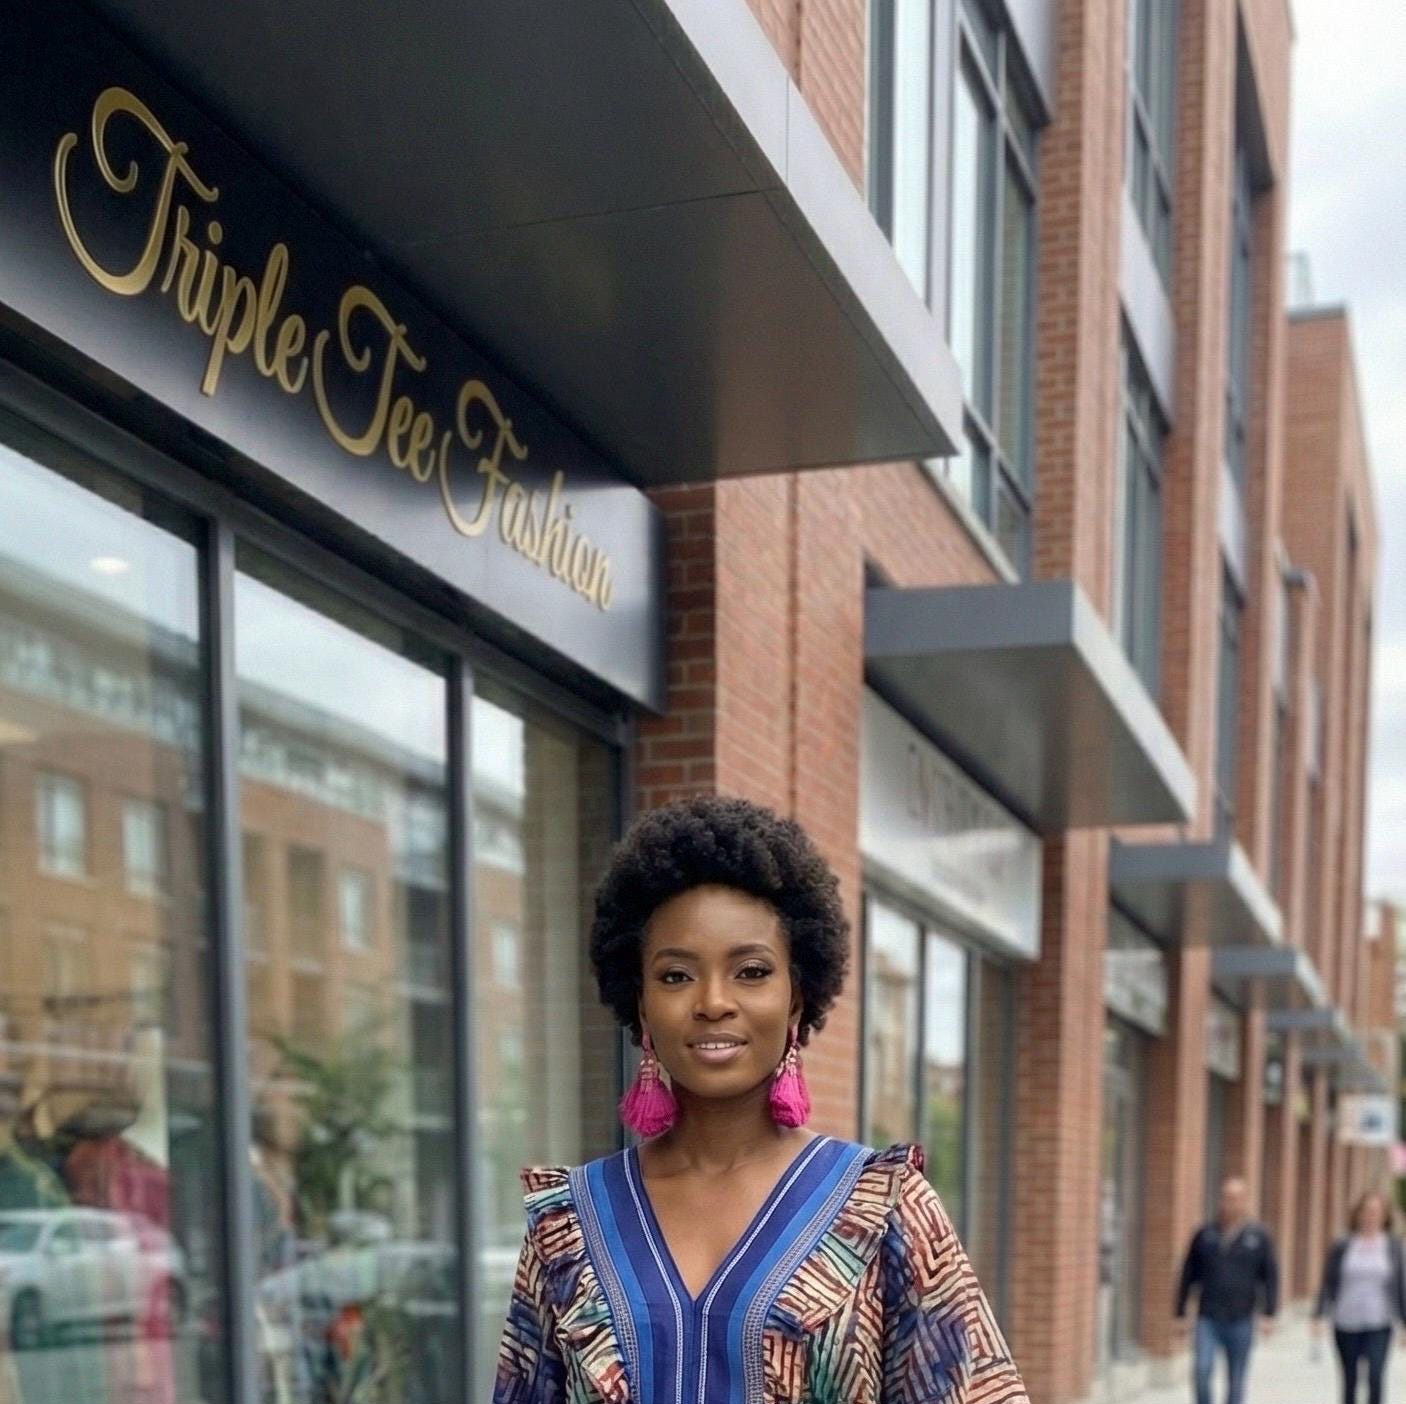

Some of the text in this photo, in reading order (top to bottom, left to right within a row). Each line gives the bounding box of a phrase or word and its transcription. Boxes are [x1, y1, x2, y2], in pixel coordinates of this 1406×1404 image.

[54, 86, 614, 612] Triple Tee Fashion
